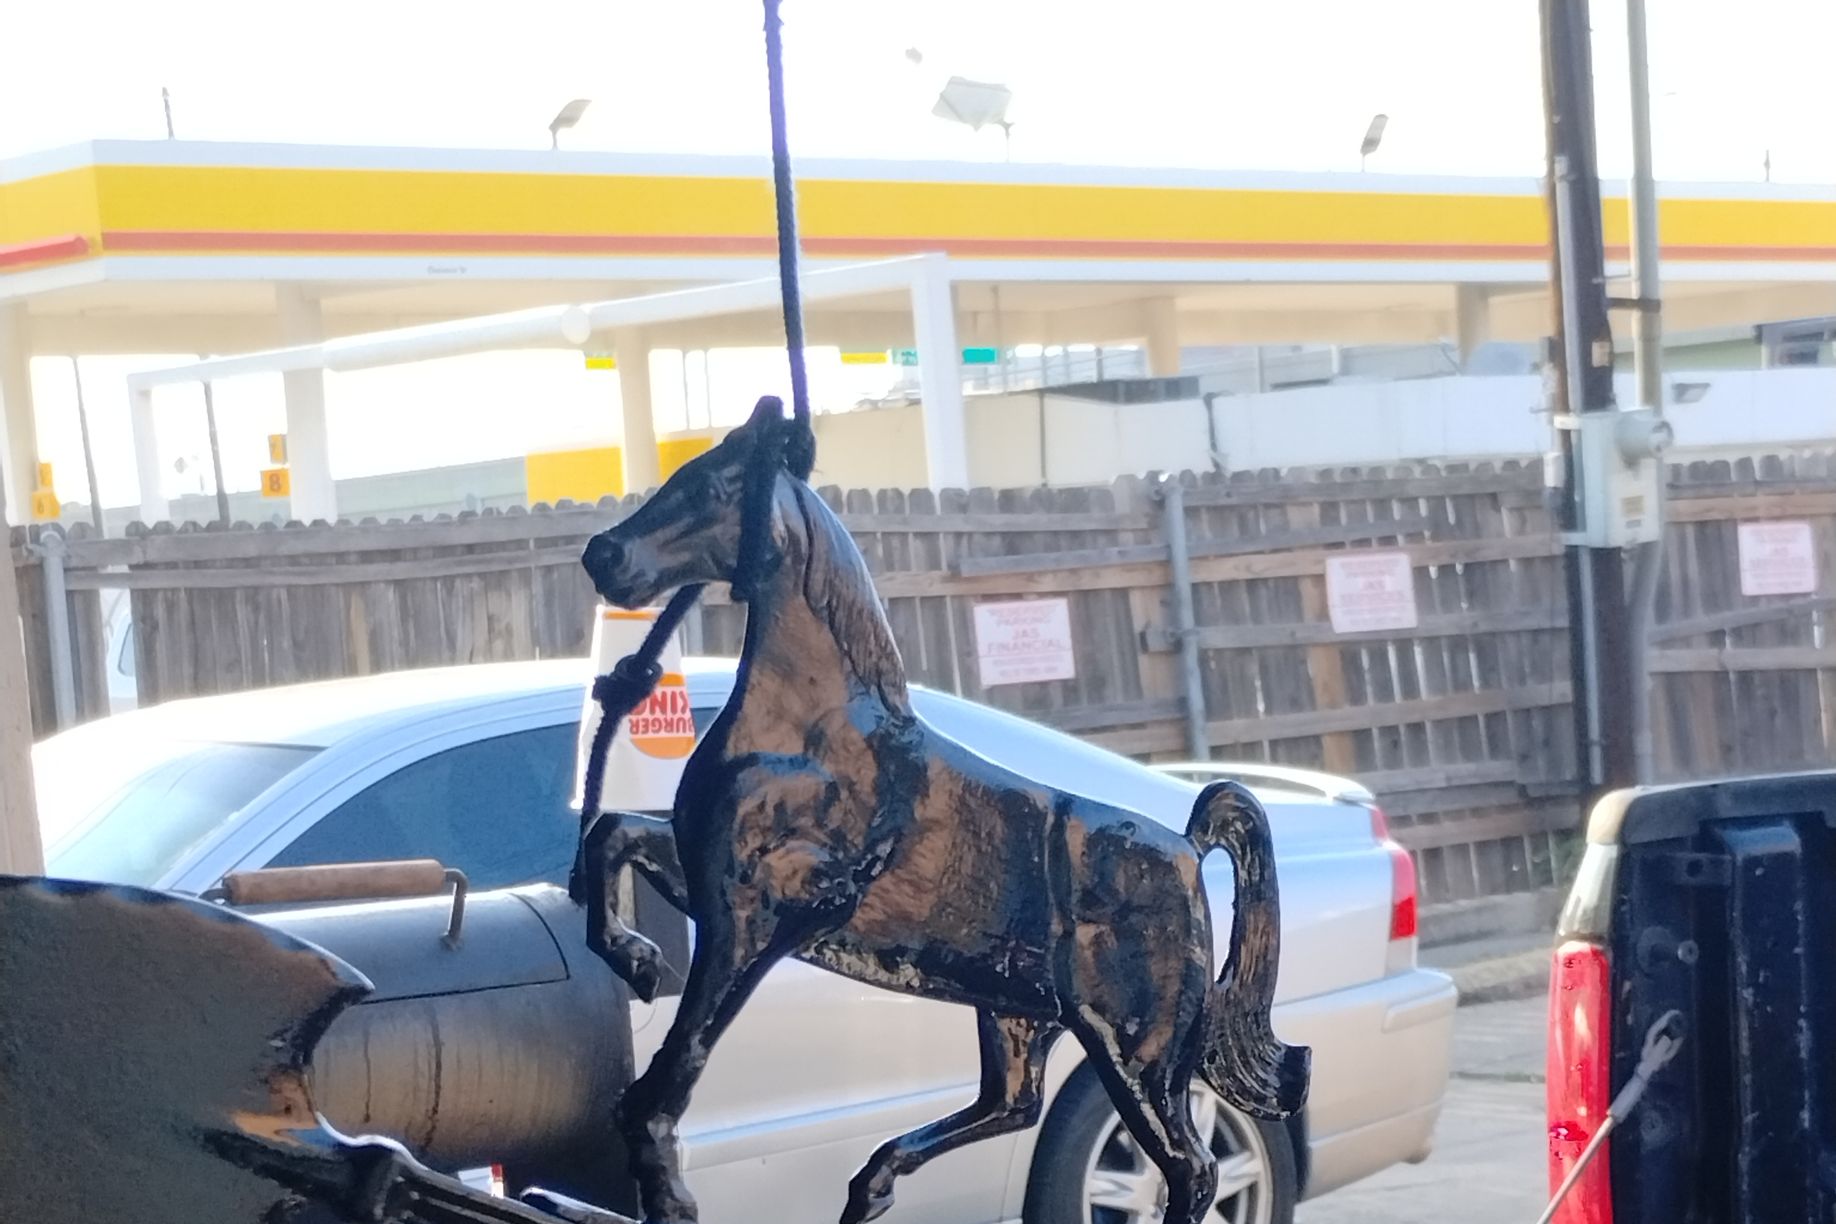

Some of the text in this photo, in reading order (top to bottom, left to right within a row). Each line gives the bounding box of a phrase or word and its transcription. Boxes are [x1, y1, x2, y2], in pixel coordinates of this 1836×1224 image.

[269, 472, 282, 492] 8
[1011, 626, 1041, 641] JAS
[986, 638, 1066, 655] FINANCIAL
[629, 717, 694, 735] BURGER
